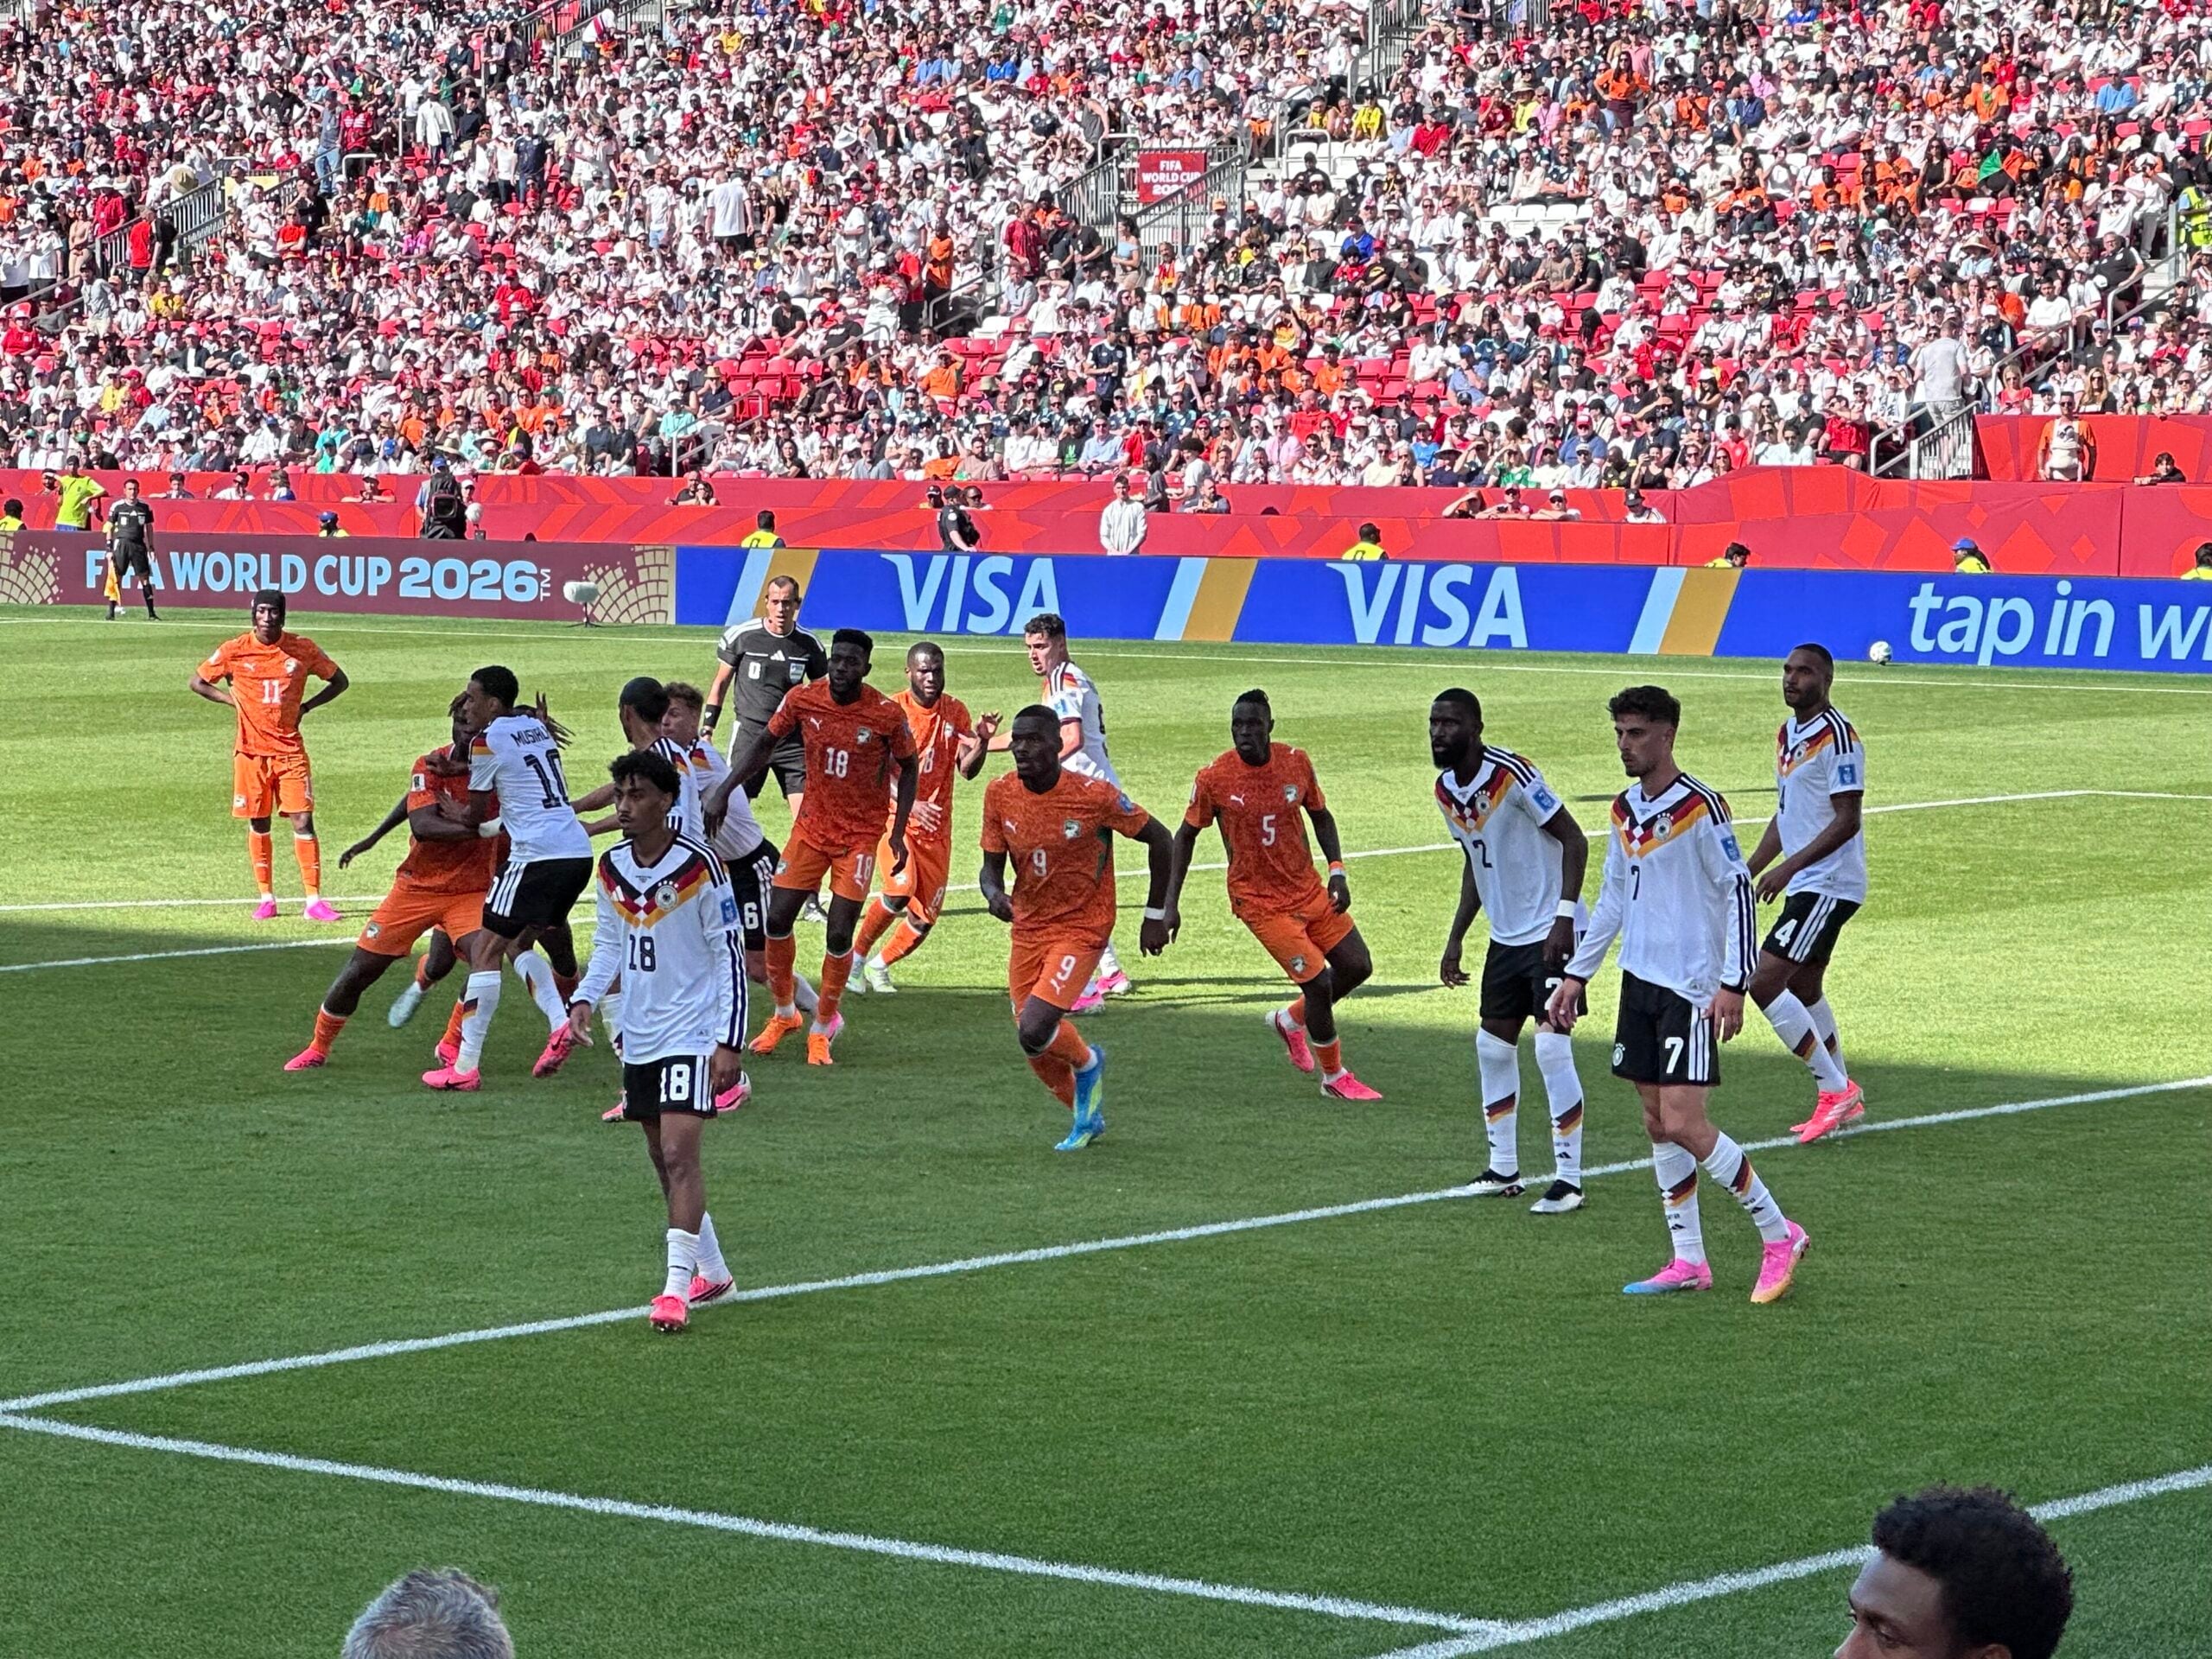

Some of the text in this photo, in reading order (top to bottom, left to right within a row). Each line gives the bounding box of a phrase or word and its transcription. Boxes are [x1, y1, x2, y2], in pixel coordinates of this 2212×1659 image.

[1141, 172, 1201, 183] WORLD CUP
[1160, 160, 1182, 171] FIFA
[1152, 183, 1185, 195] 202
[169, 551, 307, 594] WORLD
[314, 555, 391, 596] CUP
[399, 556, 539, 602] 2026
[880, 553, 1061, 634] VISA
[1325, 563, 1529, 647] VISA
[1909, 582, 2034, 665] tap
[2044, 580, 2115, 657] in
[262, 679, 283, 704] 11
[824, 747, 849, 778] 18
[1262, 814, 1276, 846] 5
[855, 854, 873, 880] 18
[1033, 849, 1047, 877] 9
[1472, 839, 1492, 868] 2
[1631, 865, 1640, 900] 7
[744, 902, 759, 930] 6
[1775, 918, 1798, 947] 4
[628, 934, 657, 972] 18
[1057, 955, 1077, 981] 9
[1665, 1037, 1684, 1074] 7
[661, 1064, 691, 1102] 18
